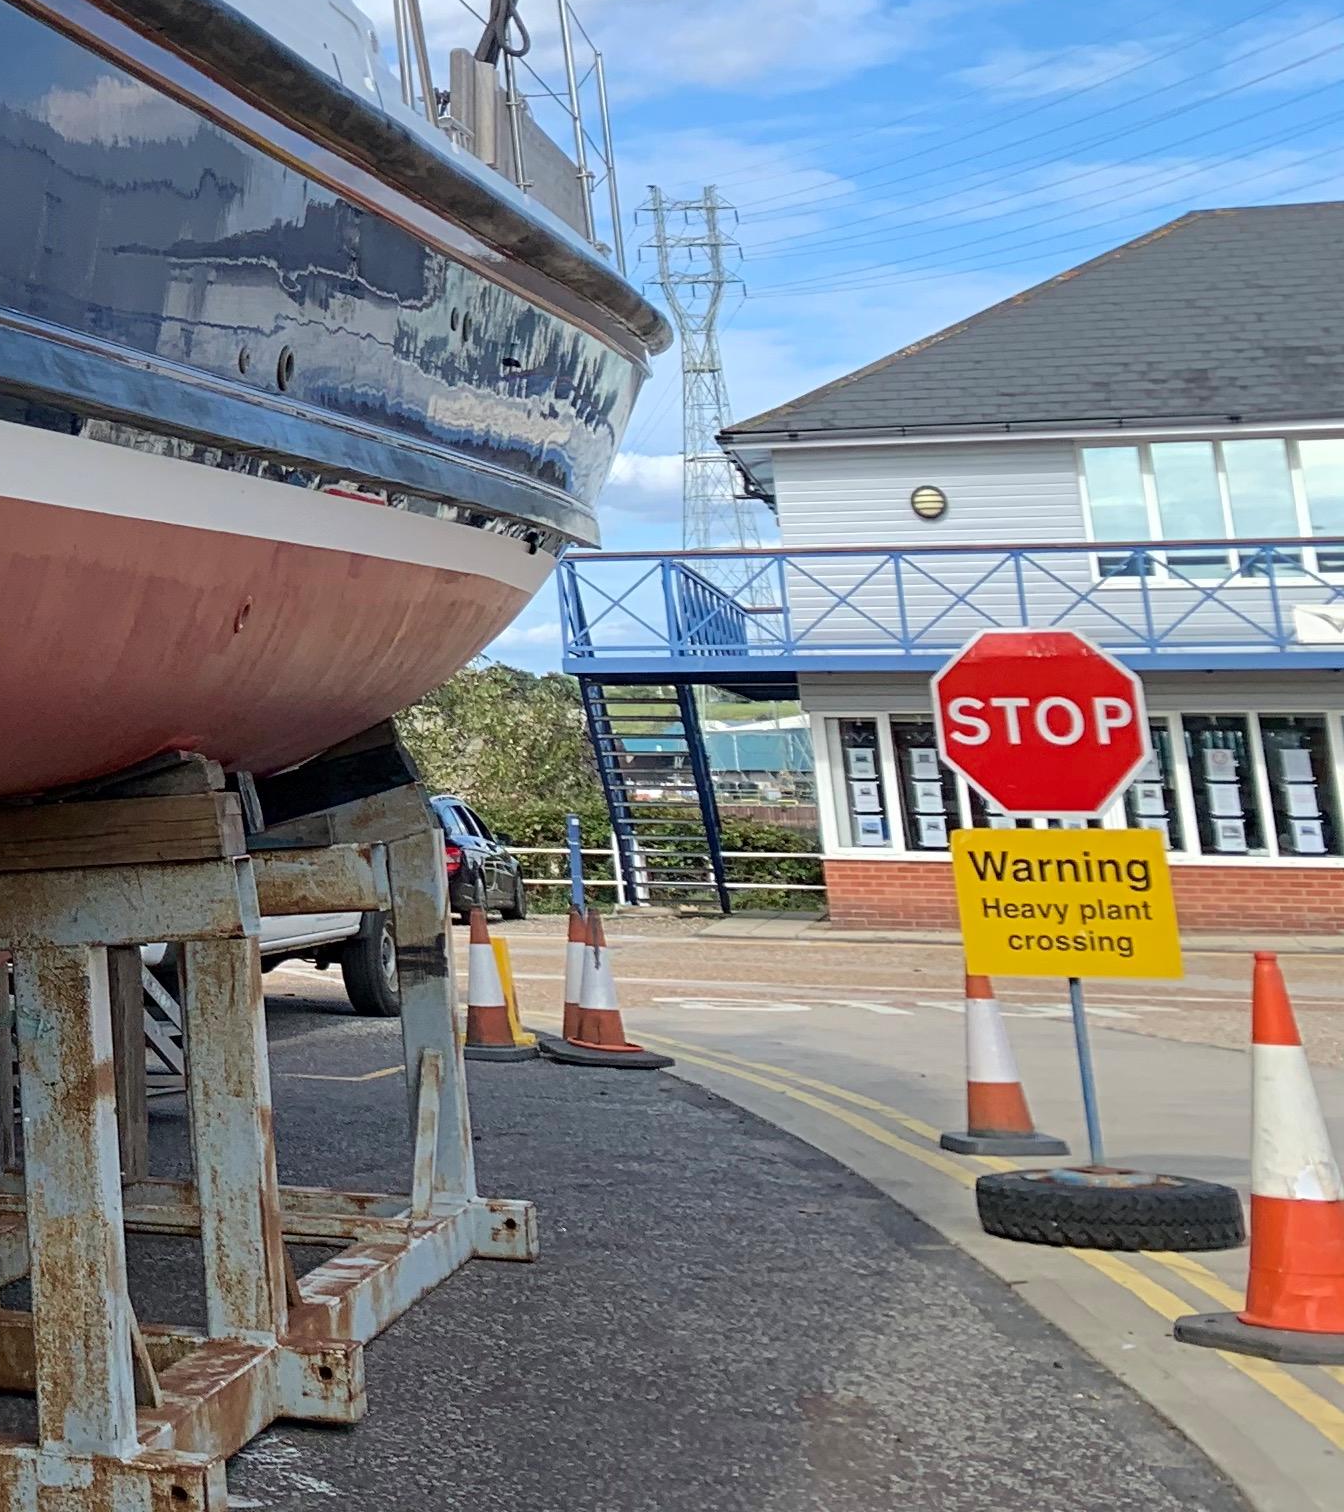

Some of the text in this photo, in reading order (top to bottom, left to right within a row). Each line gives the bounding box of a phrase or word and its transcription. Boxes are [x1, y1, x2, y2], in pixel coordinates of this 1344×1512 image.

[947, 697, 1133, 746] STOP
[968, 851, 1151, 891] Warning
[981, 898, 1153, 925] Heavy plant
[1008, 930, 1135, 958] crossing
